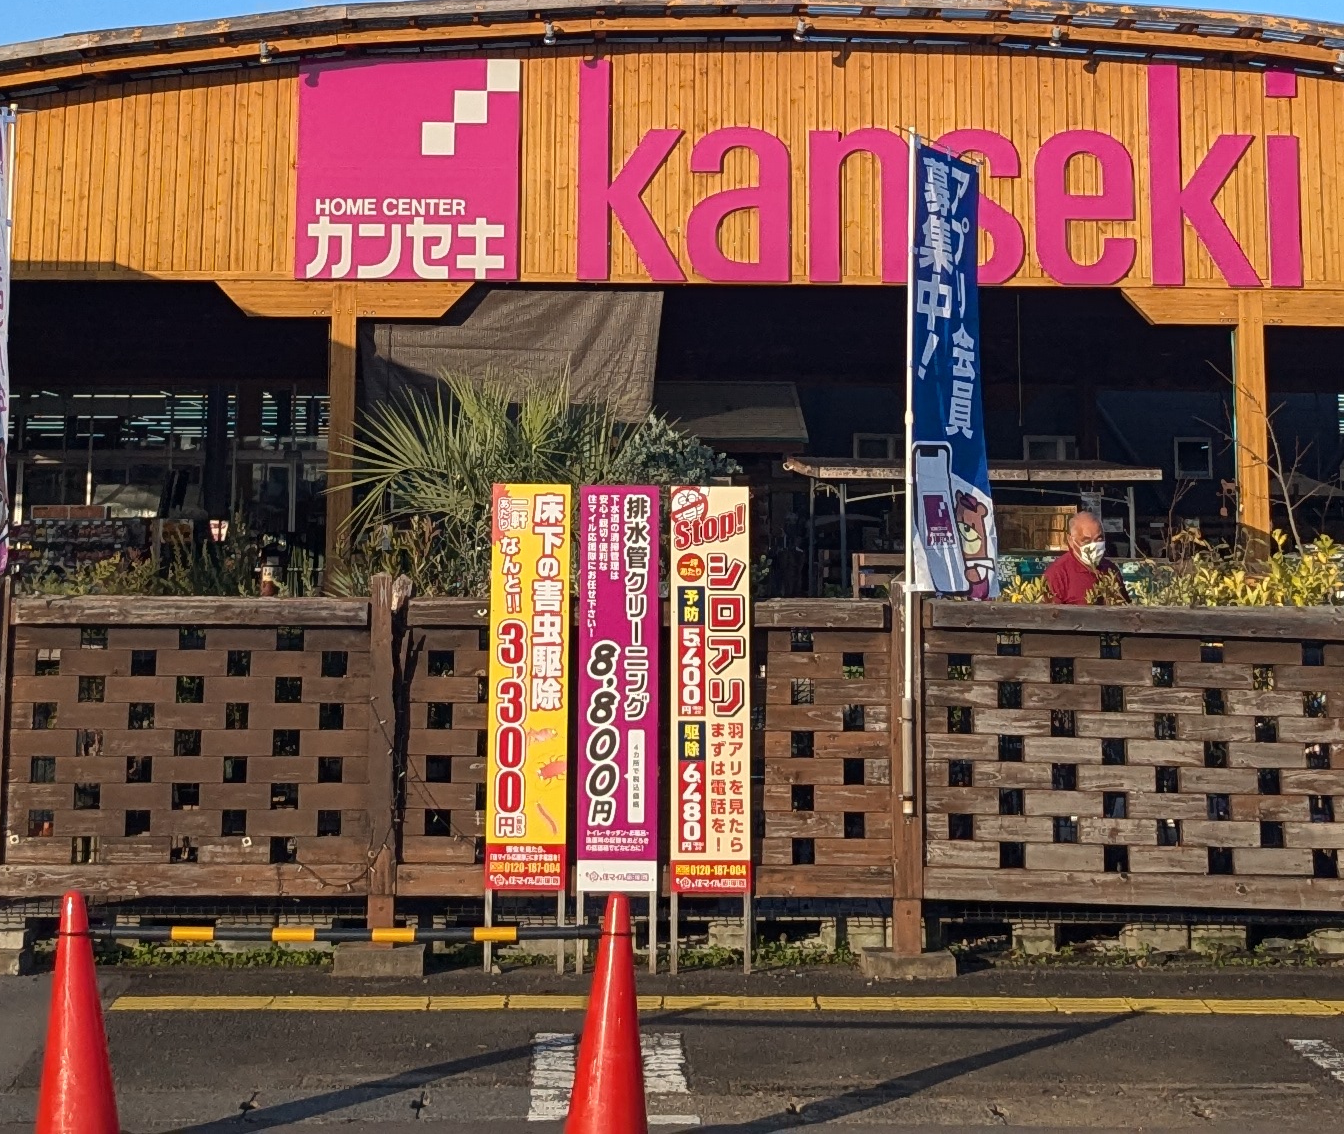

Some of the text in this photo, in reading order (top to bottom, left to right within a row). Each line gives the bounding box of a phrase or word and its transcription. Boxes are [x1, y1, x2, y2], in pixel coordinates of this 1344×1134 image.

[315, 198, 466, 215] HOME CENTER
[577, 59, 1304, 287] kanseki
[305, 216, 505, 279] カンセキ
[945, 167, 976, 439] アプリ会員
[498, 498, 511, 531] あたり
[510, 498, 529, 530] 一軒
[674, 503, 746, 550] Stop!
[531, 493, 566, 711] 床下の害虫駆除
[624, 494, 650, 721] 排水管クリーニング
[684, 589, 700, 622] 予防
[707, 553, 746, 717] シロアリ
[586, 640, 621, 826] 8,800円
[684, 724, 700, 758] 駆除
[711, 723, 727, 852] まずは電話を!
[728, 722, 745, 852] 羽アリを見たら
